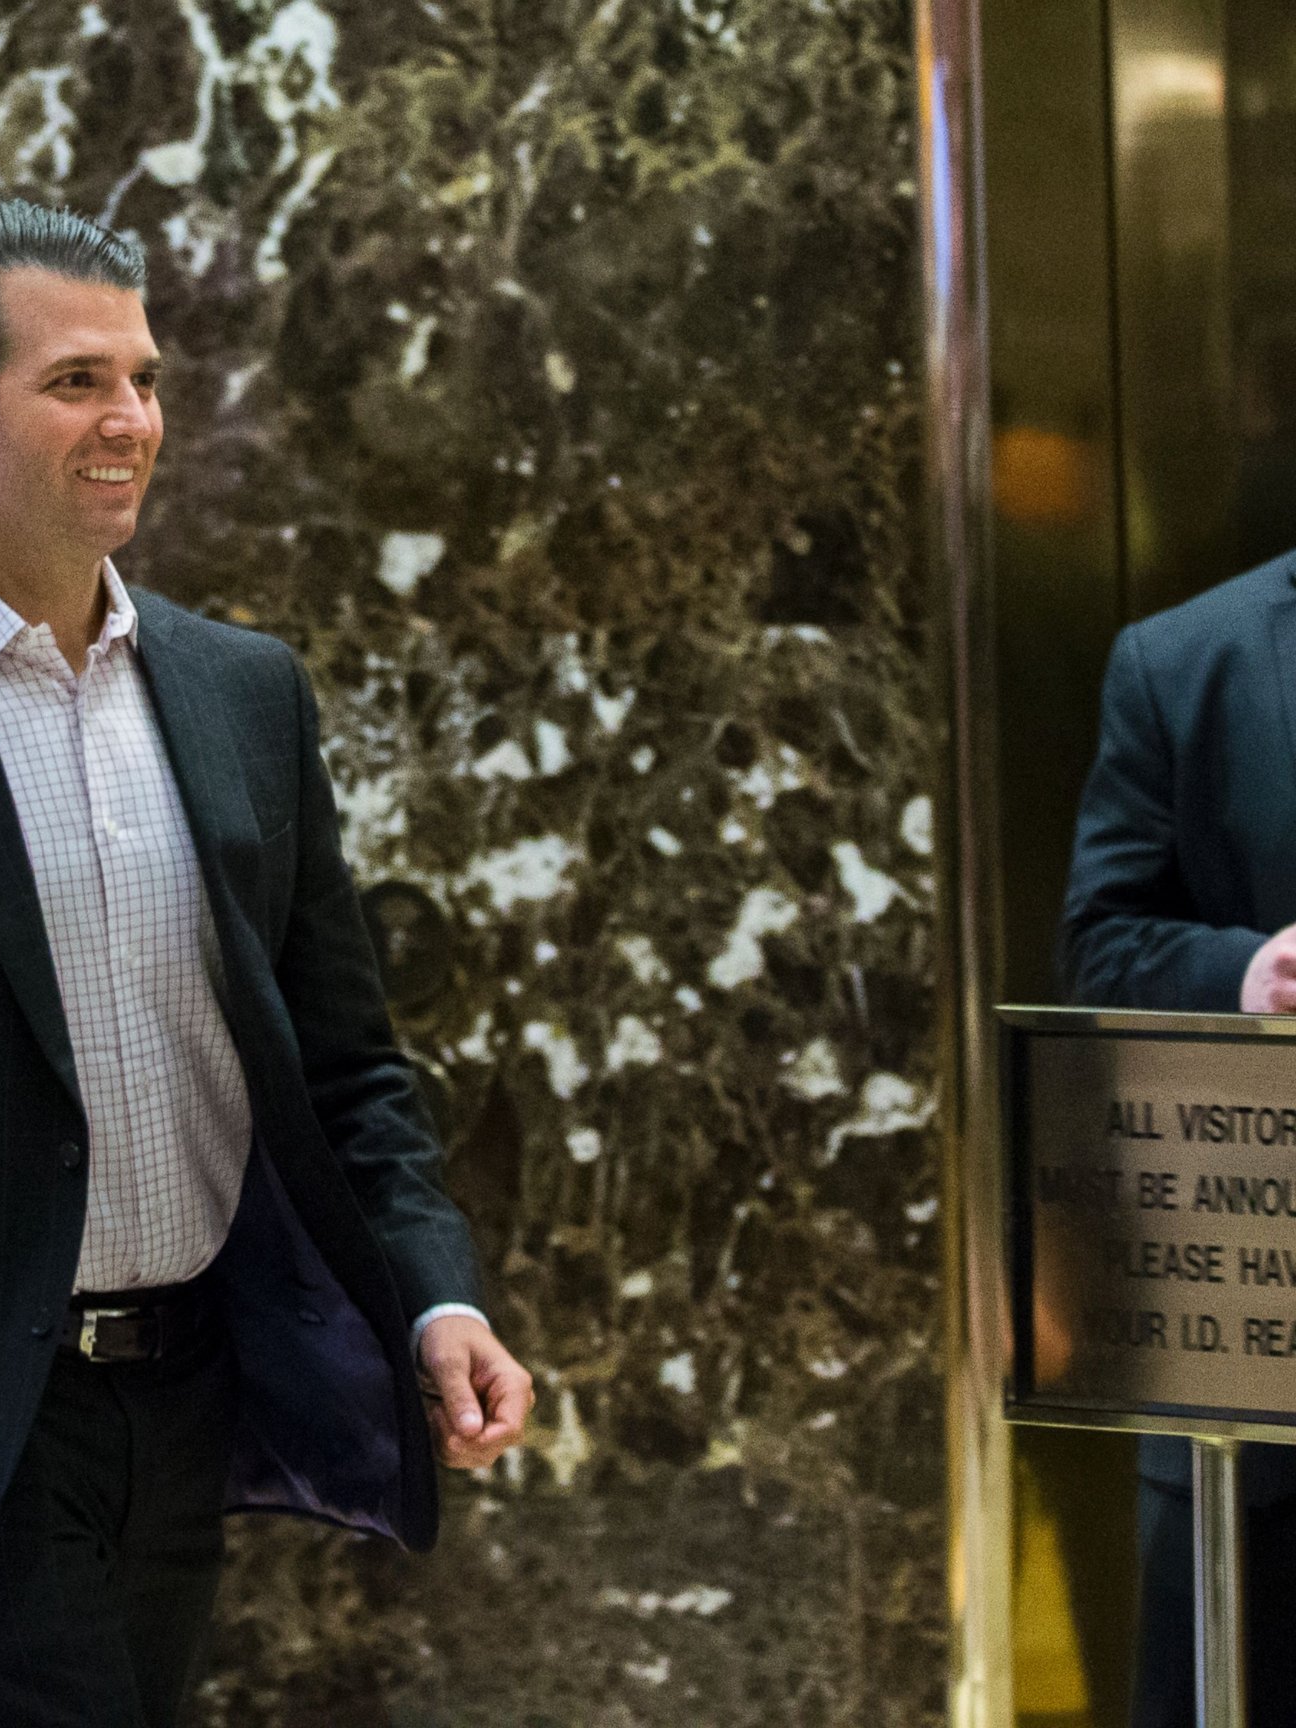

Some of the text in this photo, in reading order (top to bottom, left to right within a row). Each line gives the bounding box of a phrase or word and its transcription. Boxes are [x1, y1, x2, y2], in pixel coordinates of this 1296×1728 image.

[1106, 1100, 1296, 1146] ALL VISITOR
[1137, 1171, 1179, 1211] BE
[1102, 1239, 1225, 1284] PLEASE
[1180, 1312, 1230, 1355] I.D.
